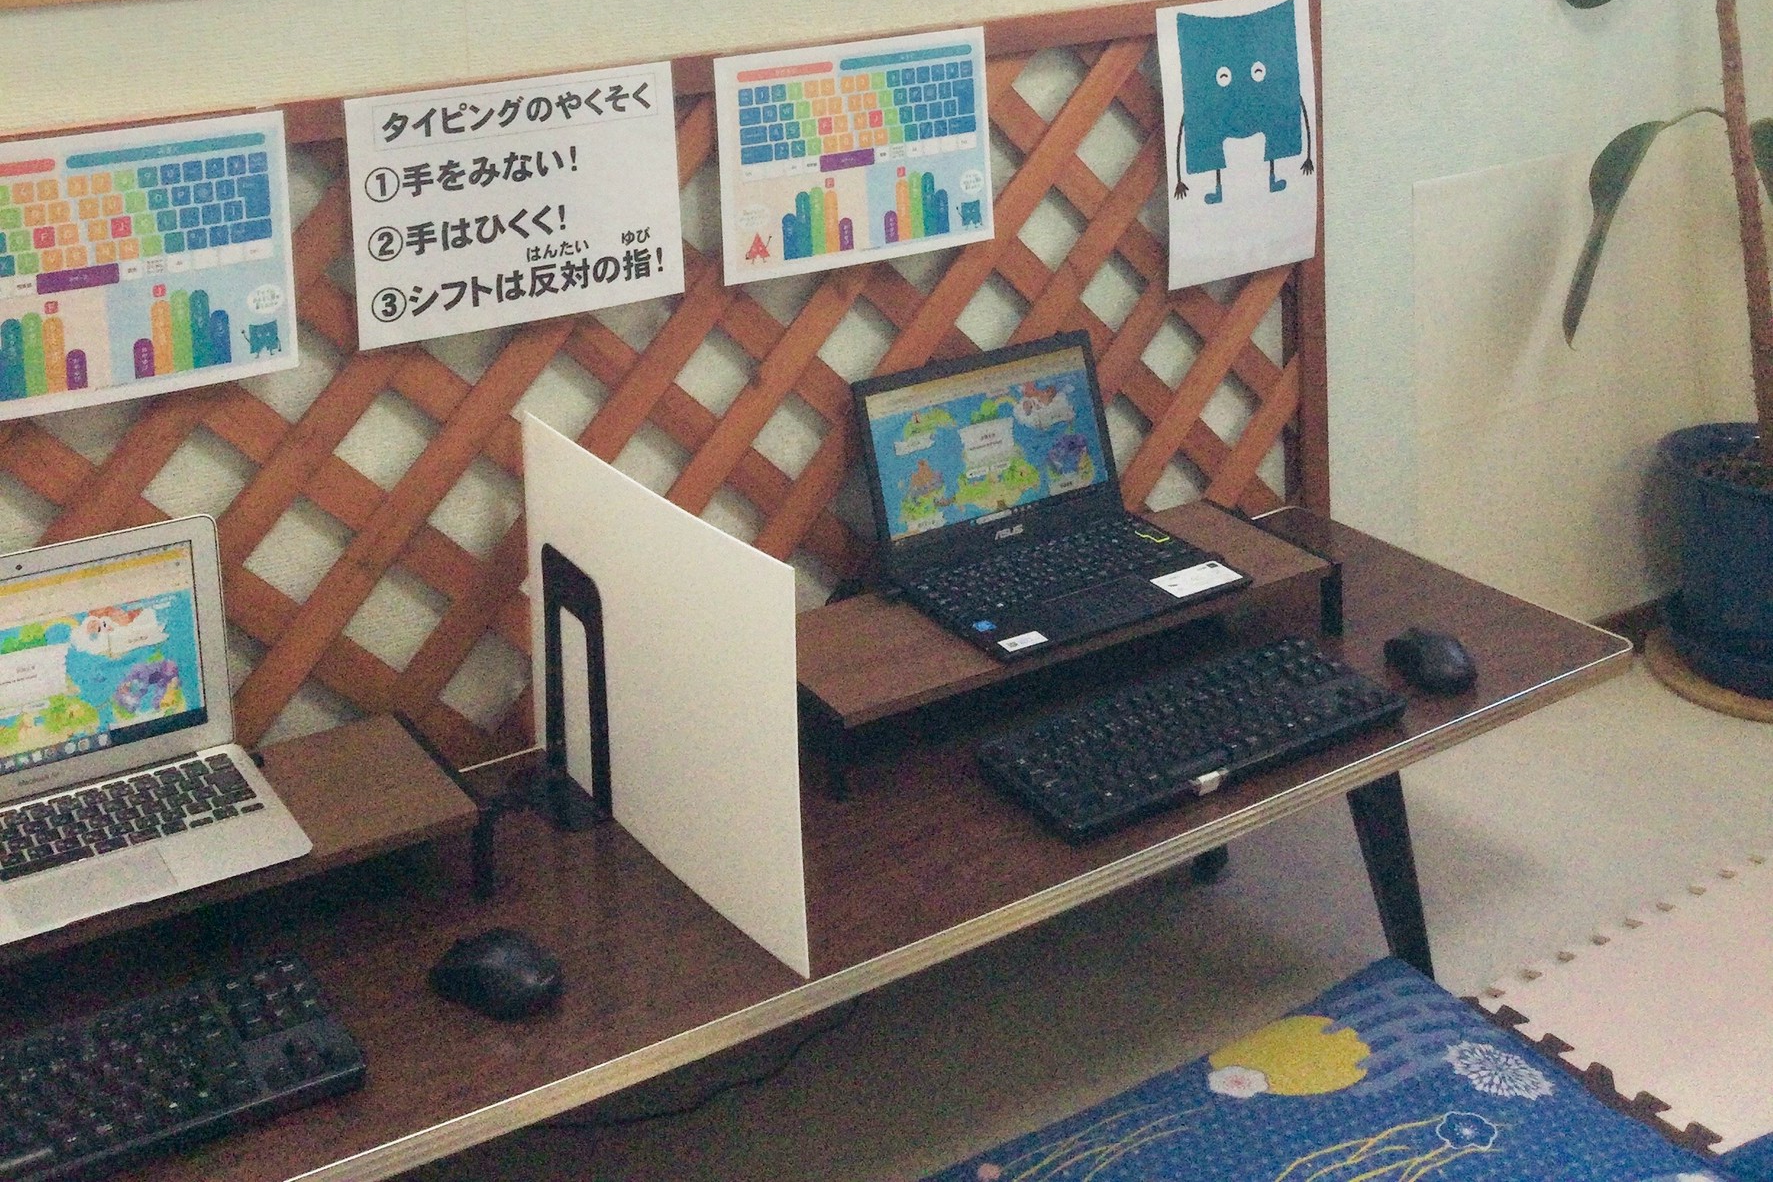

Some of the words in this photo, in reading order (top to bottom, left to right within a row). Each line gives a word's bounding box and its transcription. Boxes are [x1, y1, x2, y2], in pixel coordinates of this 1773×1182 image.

[382, 82, 651, 143] タイピングのやくそく
[527, 238, 590, 262] はんたい
[621, 227, 651, 246] ゆび
[994, 524, 1024, 541] ASUS
